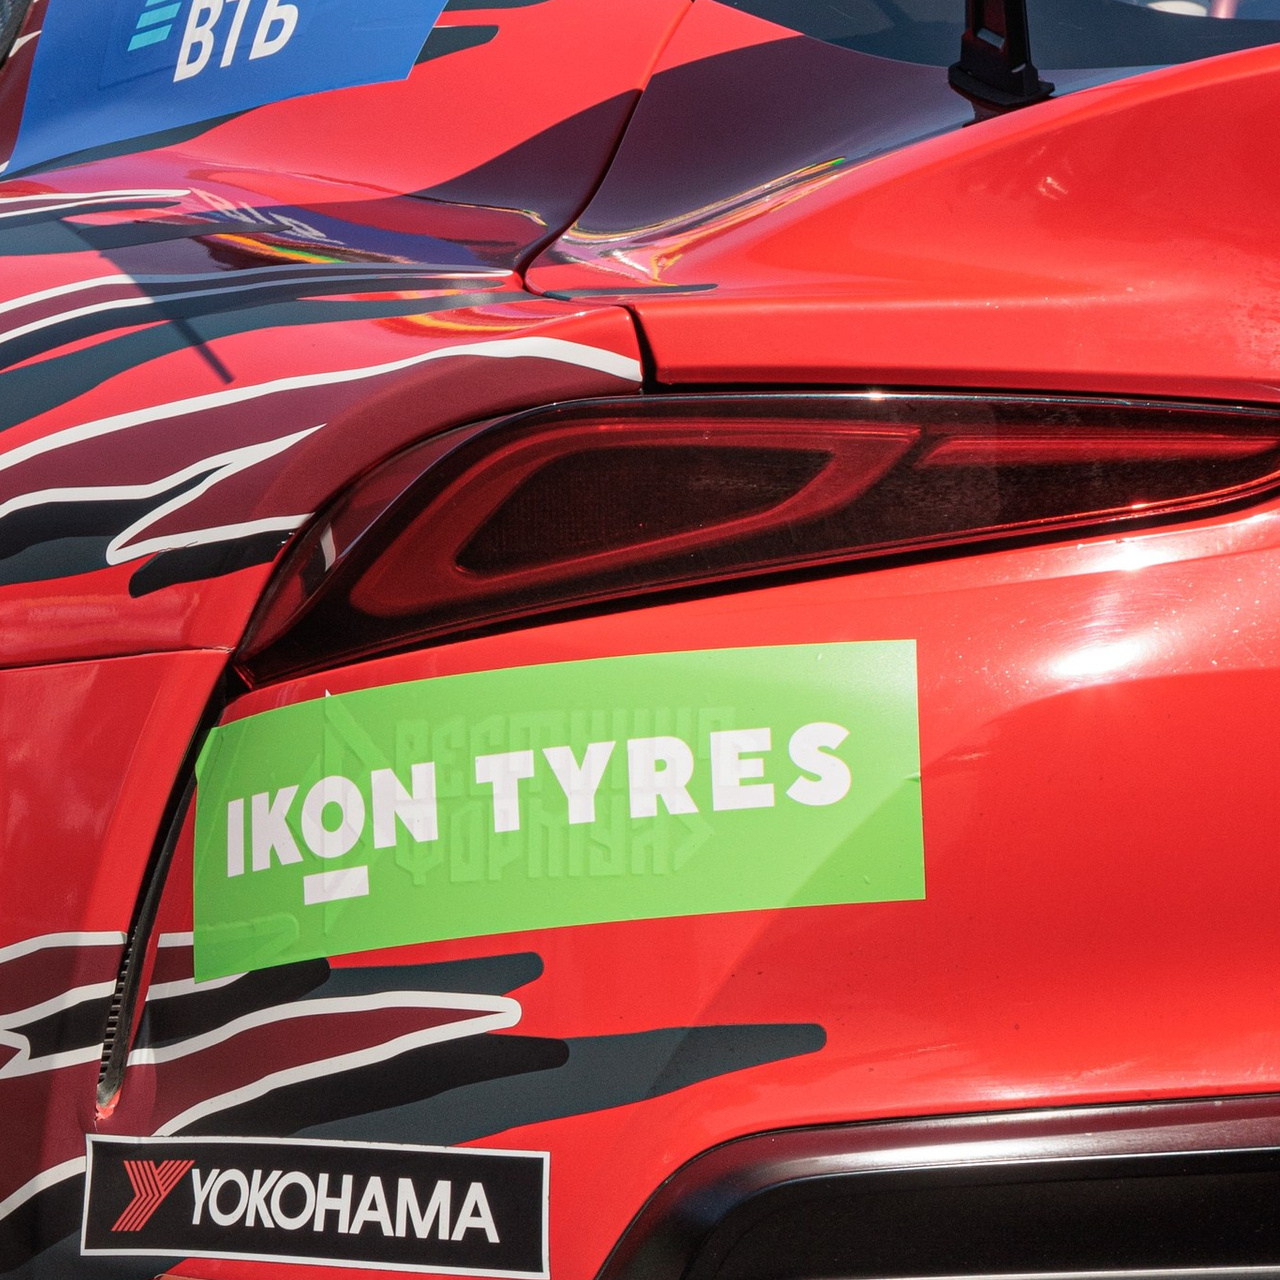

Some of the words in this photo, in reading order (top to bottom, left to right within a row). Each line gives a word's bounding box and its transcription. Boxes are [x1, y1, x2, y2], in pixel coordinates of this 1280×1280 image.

[227, 762, 439, 888] IKON
[474, 721, 853, 834] TYRES
[191, 1168, 501, 1244] YOKOHAMA
